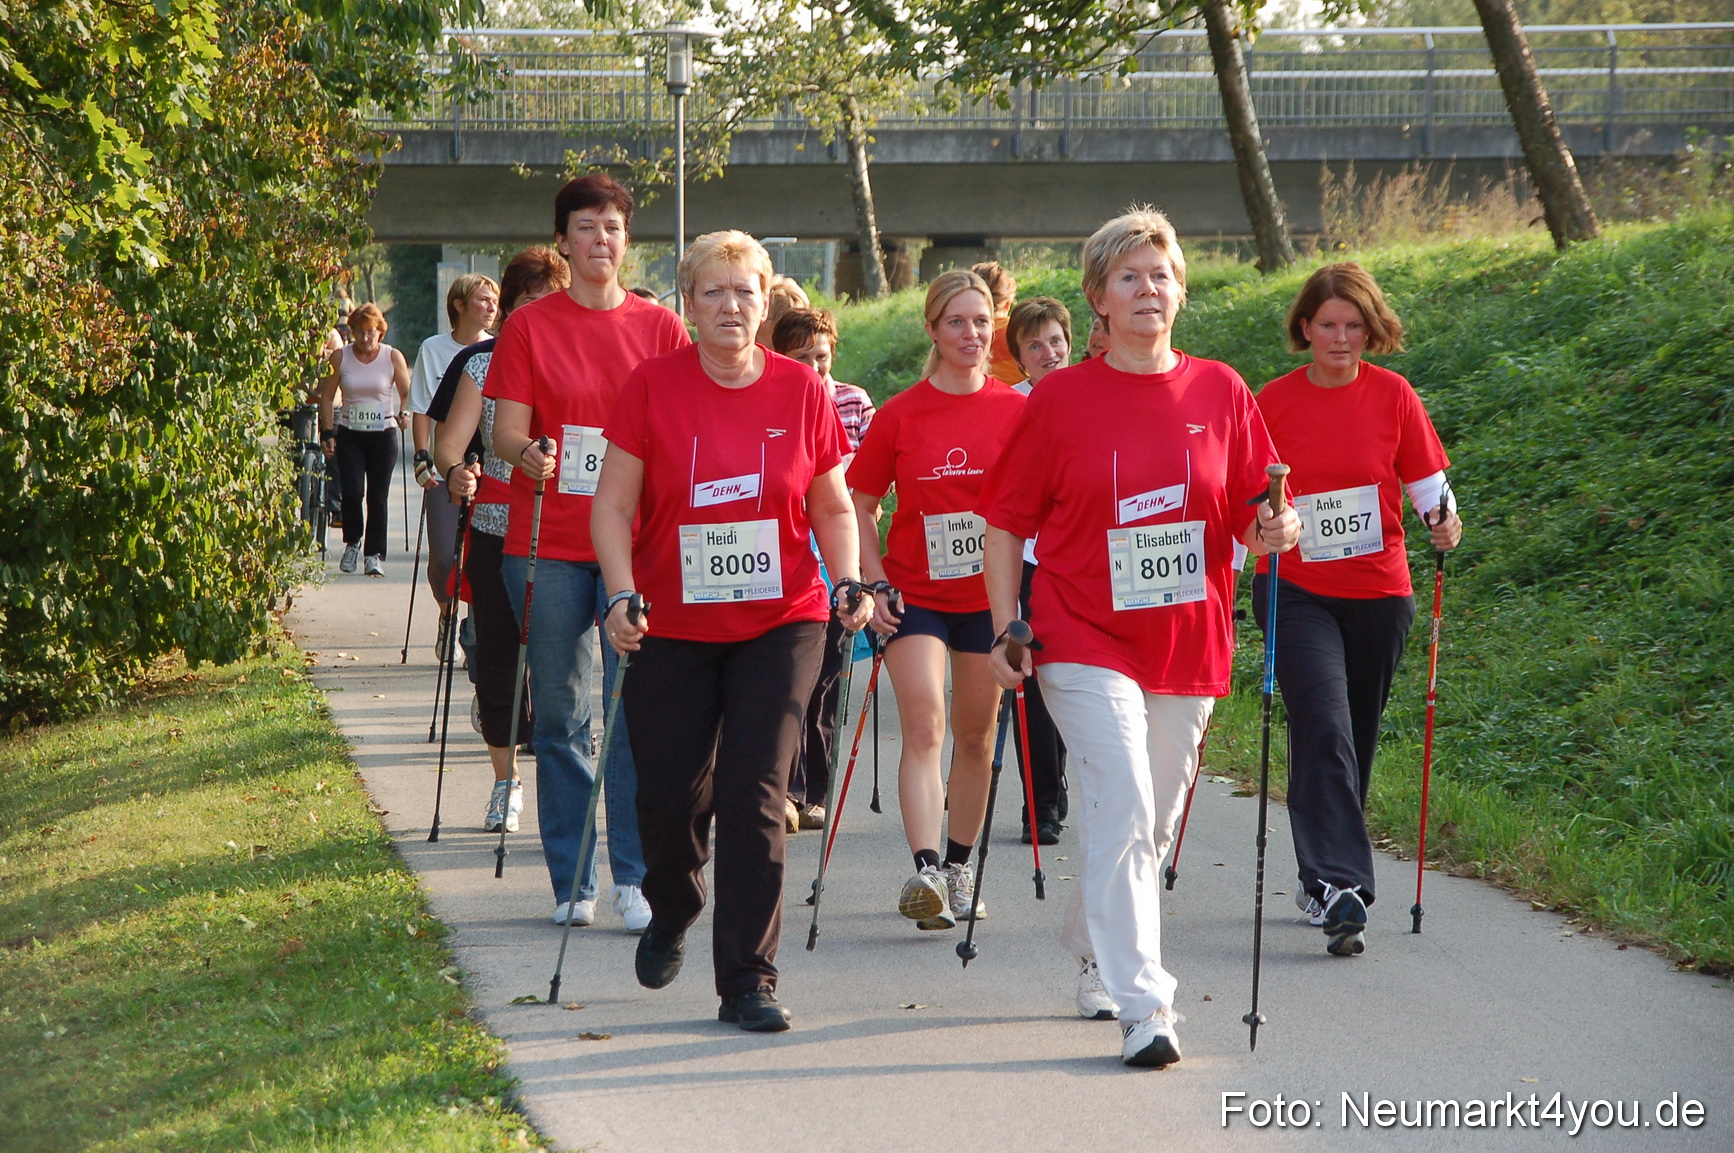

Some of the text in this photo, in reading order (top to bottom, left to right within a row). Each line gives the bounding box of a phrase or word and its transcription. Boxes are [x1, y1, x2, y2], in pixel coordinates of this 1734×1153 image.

[359, 411, 381, 421] 8104
[564, 450, 571, 460] N
[712, 484, 741, 497] DEHN
[1137, 496, 1165, 512] DEHN
[1316, 497, 1342, 512] Anke
[948, 518, 973, 532] Imke
[1320, 512, 1372, 537] 8057
[707, 530, 737, 546] Heidi
[930, 540, 937, 550] N
[952, 533, 986, 556] 800
[1136, 529, 1191, 549] Elisabeth
[685, 555, 692, 566] N
[710, 552, 771, 576] 8009
[1115, 560, 1122, 571] N
[1141, 552, 1198, 580] 8010
[744, 586, 780, 595] PFLEIDERER
[1173, 587, 1205, 598] PFLEIDERER
